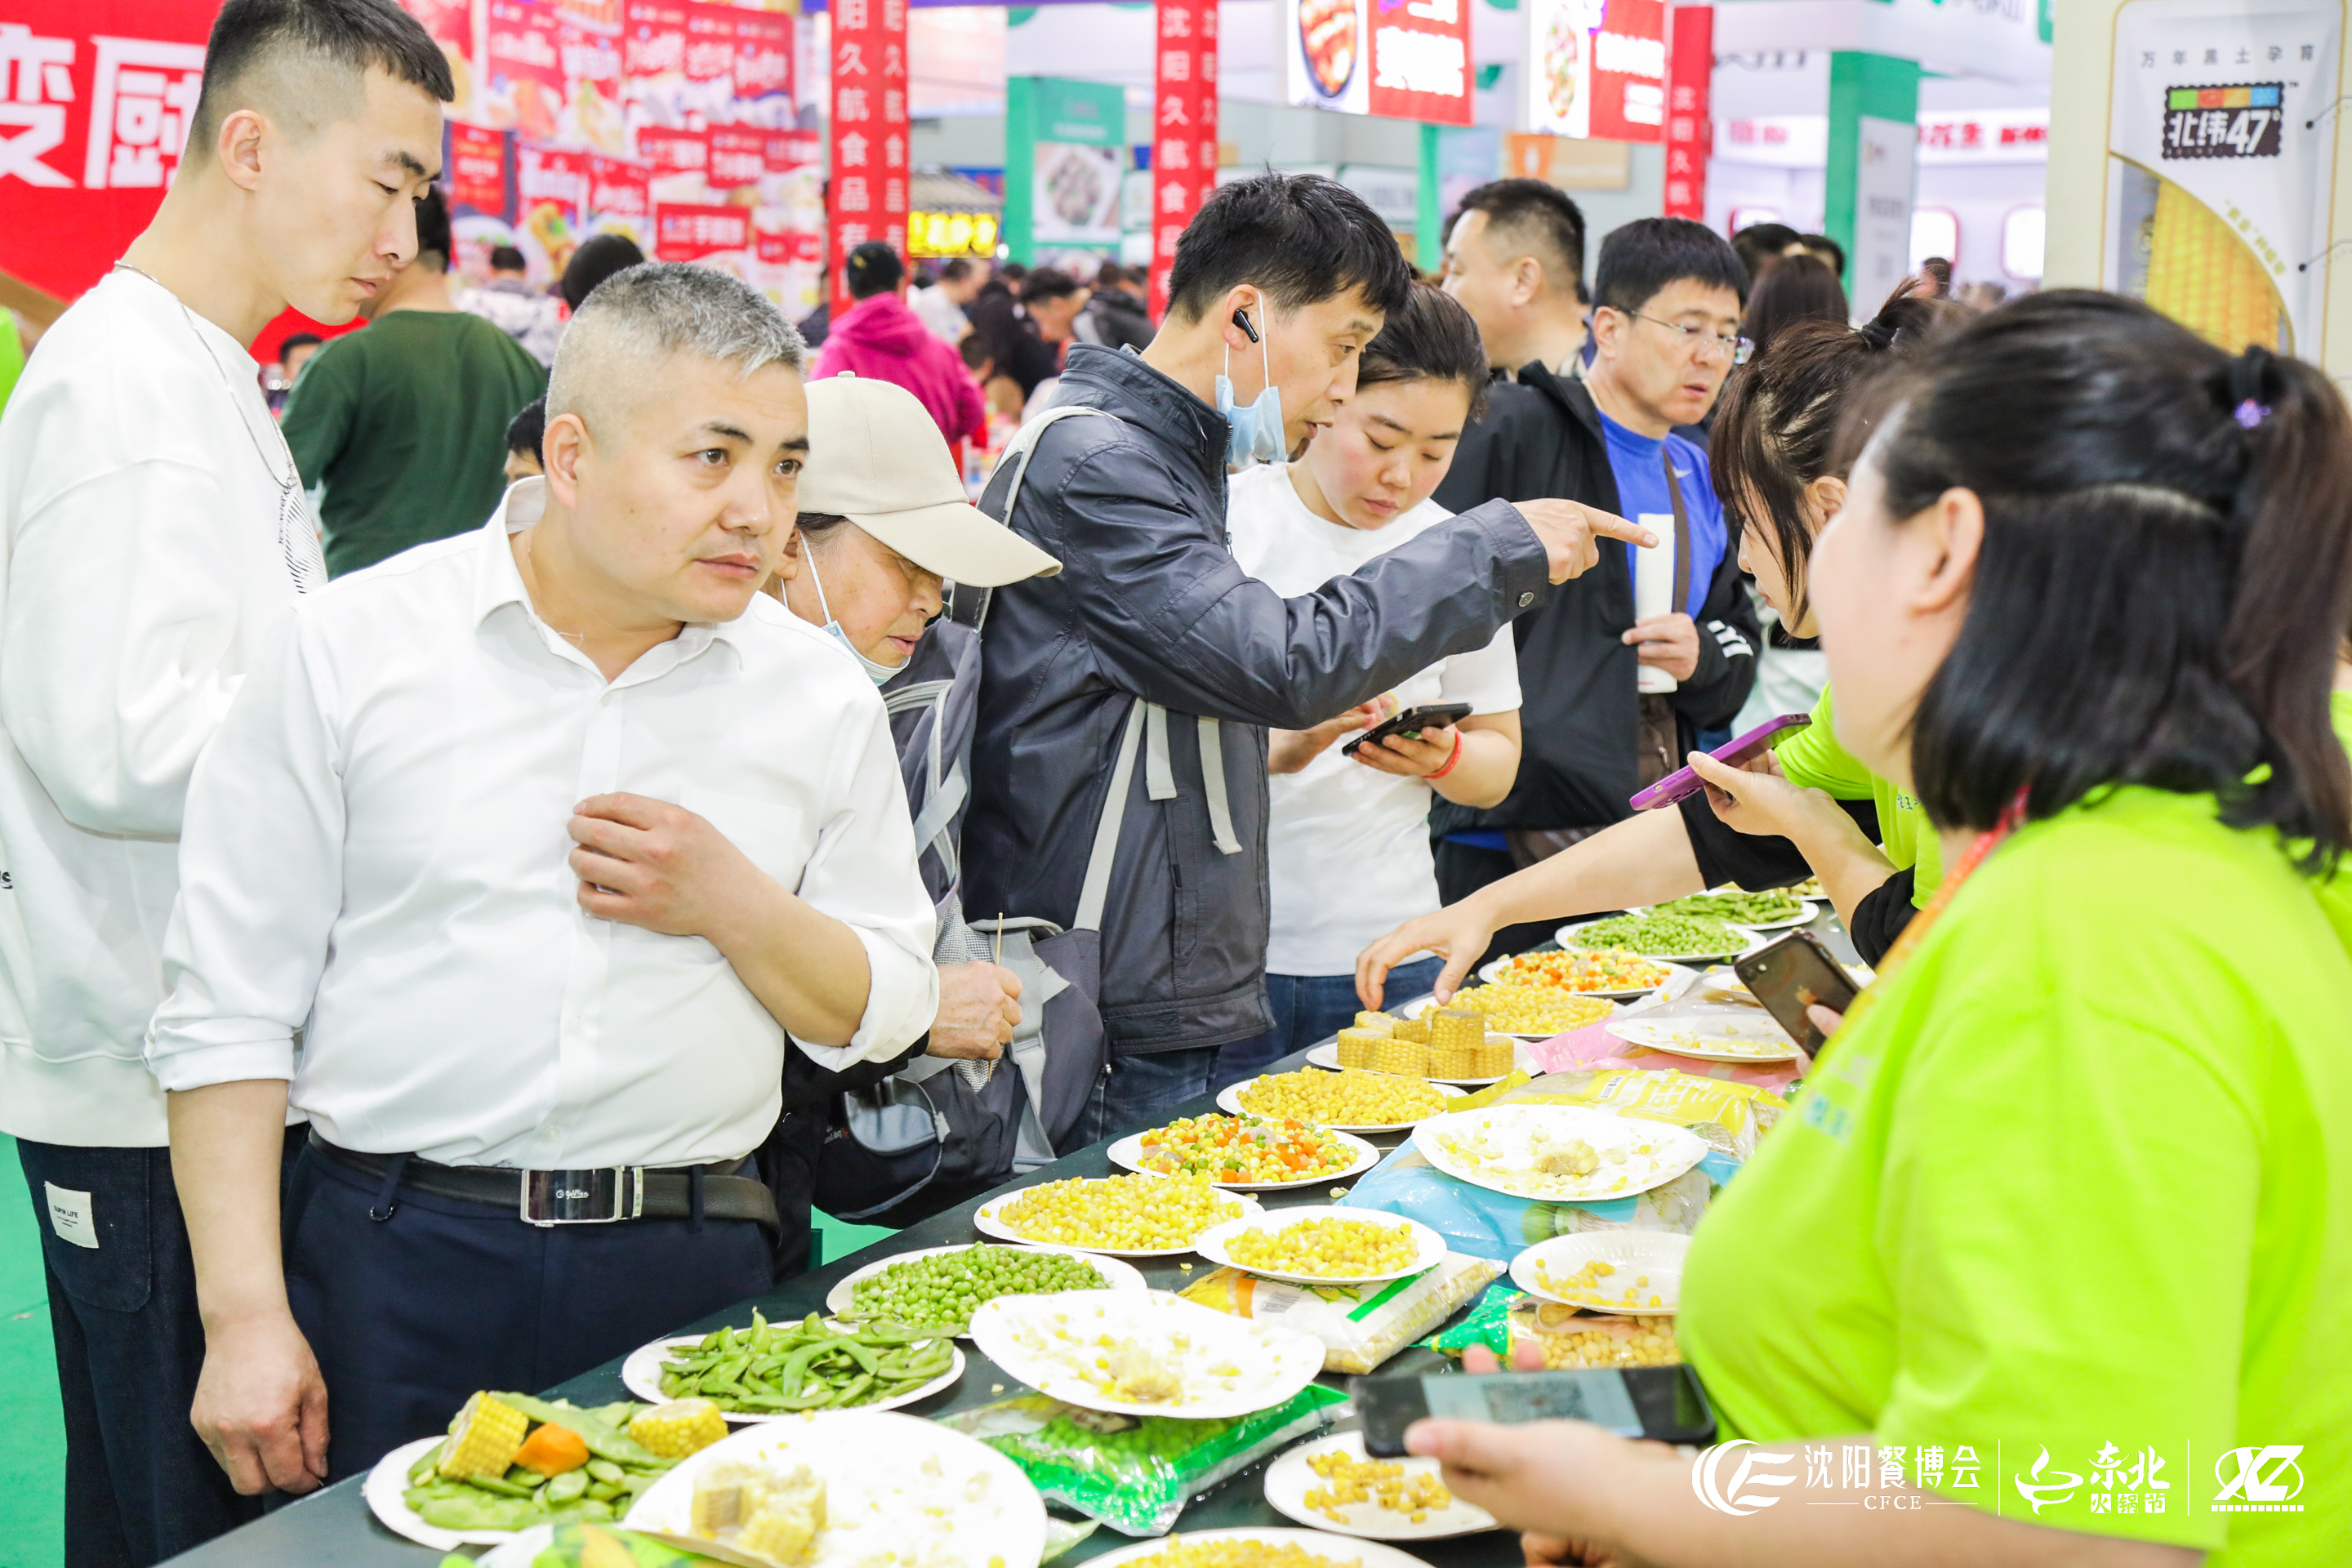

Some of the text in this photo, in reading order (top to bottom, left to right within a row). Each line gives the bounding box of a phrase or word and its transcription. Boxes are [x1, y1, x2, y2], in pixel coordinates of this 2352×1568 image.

[2141, 44, 2314, 69] 万年黑土孕育
[67, 1210, 78, 1218] LIFE
